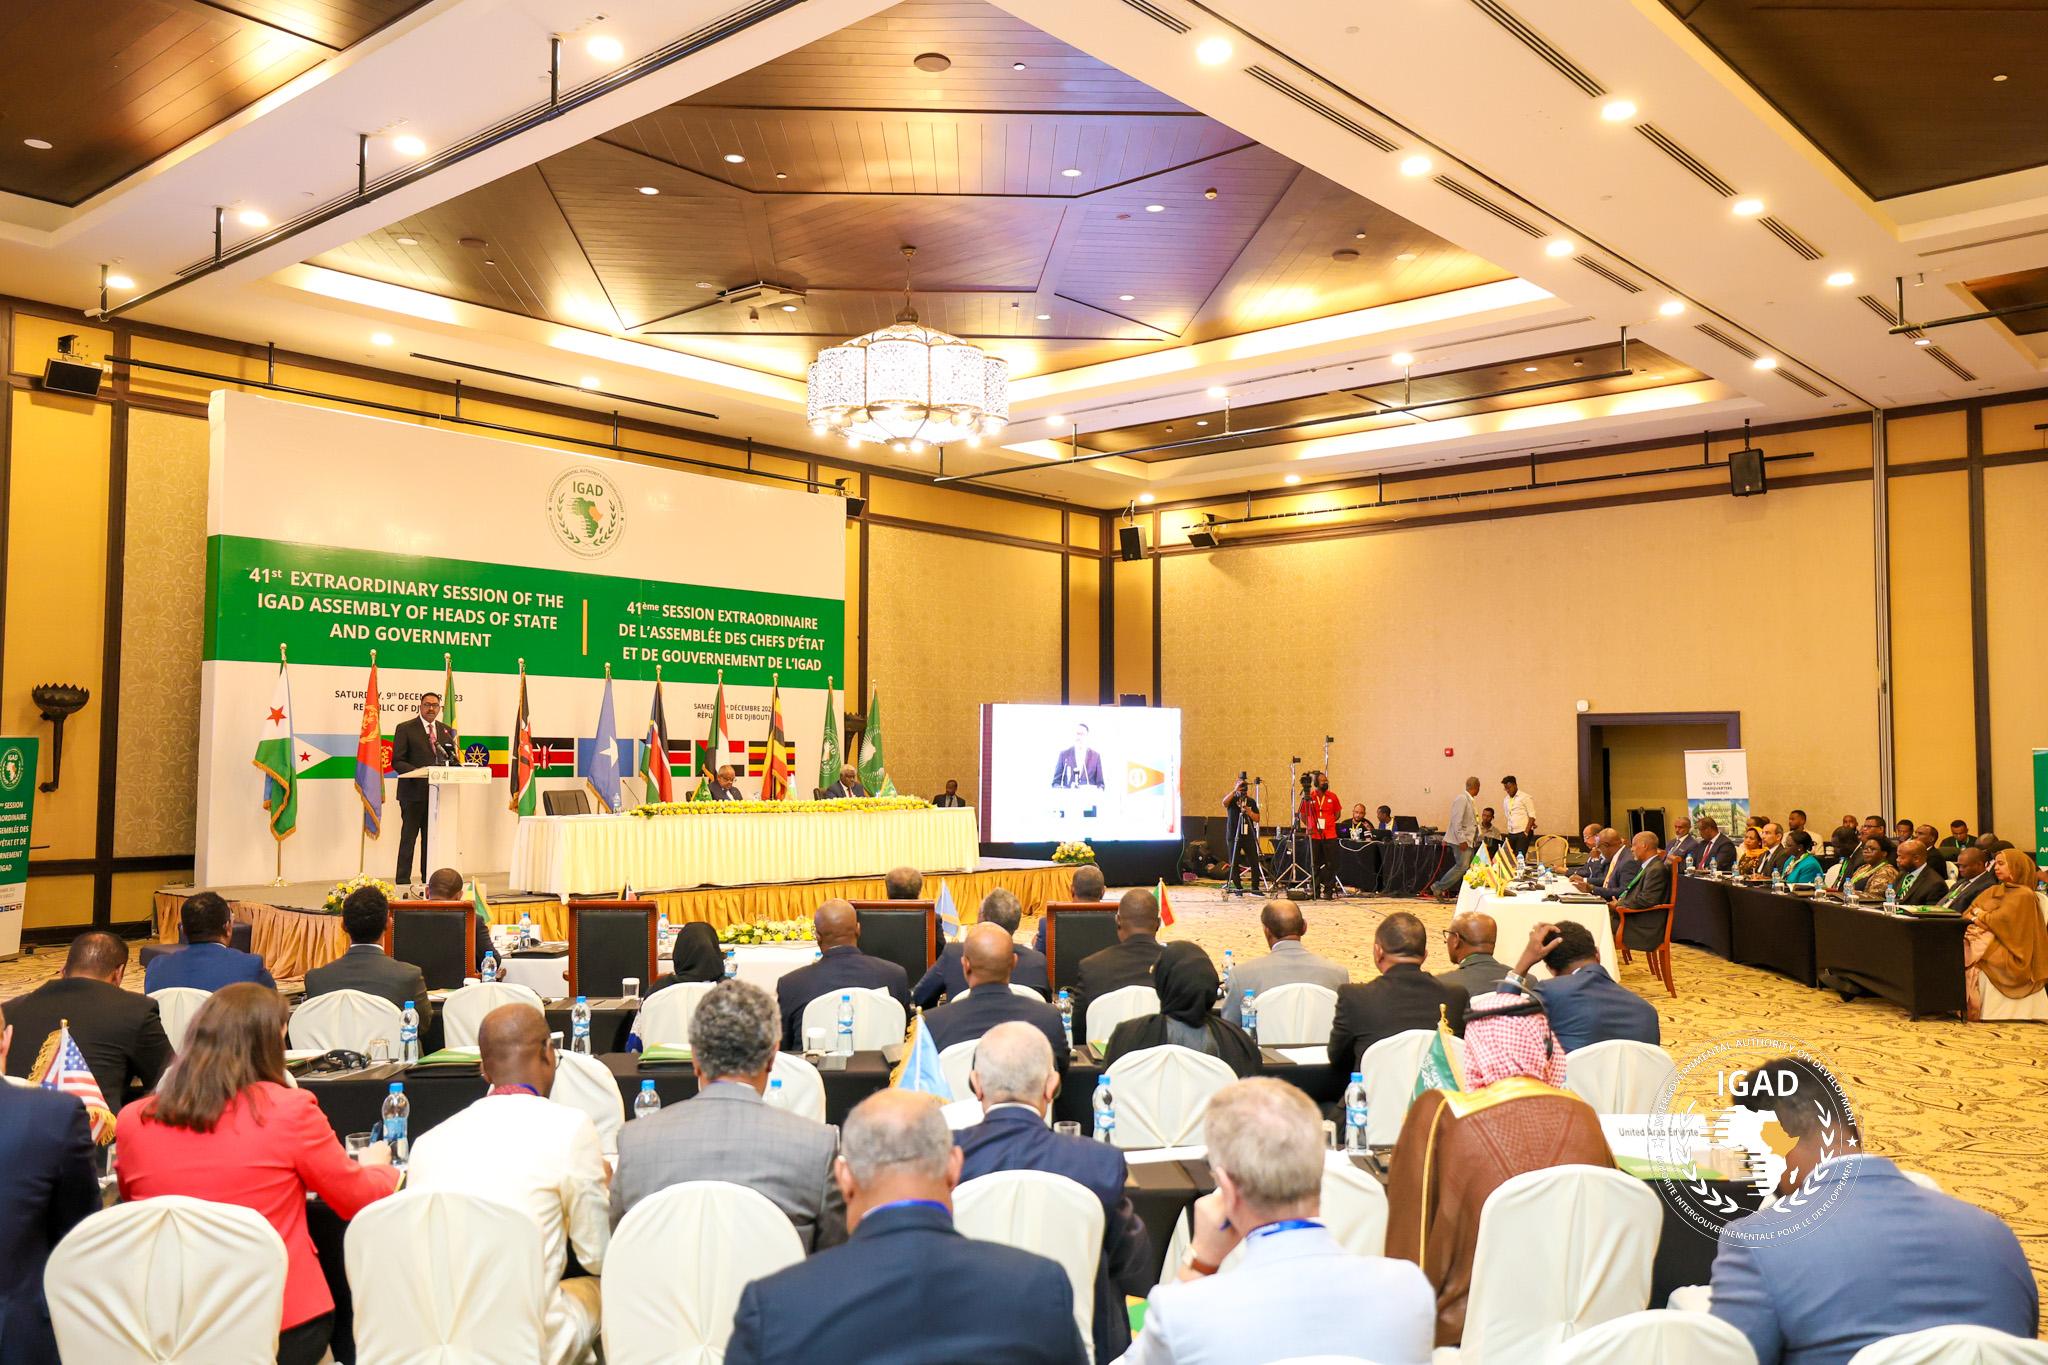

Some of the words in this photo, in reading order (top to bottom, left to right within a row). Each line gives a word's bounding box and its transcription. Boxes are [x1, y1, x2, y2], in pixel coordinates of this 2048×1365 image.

[573, 481, 603, 496] IGAD
[249, 568, 282, 583] 41st
[290, 570, 439, 597] EXTRAORDINARY
[443, 585, 508, 604] SESSION
[512, 592, 532, 605] OF
[536, 593, 564, 609] THE
[257, 593, 304, 610] IGAD
[309, 597, 401, 618] ASSEMBLY
[406, 605, 428, 620] OF
[433, 607, 485, 624] HEADS
[490, 611, 510, 626] OF
[514, 614, 557, 630] STATE
[627, 601, 659, 615] 41ème
[662, 604, 714, 621] SESSION
[718, 609, 818, 630] EXTRAORDINAIRE
[330, 623, 370, 639] AND
[375, 626, 492, 647] GOVERNMENT
[619, 624, 636, 637] DE
[640, 625, 722, 643] L'ASSEMBLÉE
[724, 632, 746, 645] DES
[750, 634, 785, 648] CHEFS
[788, 635, 825, 651] D'ÉTAT
[623, 646, 638, 660] ET
[642, 648, 658, 661] DE
[662, 649, 765, 668] GOUVERNEMENT
[768, 656, 782, 669] DE
[786, 658, 822, 671] L'IGAD
[335, 690, 384, 700] SATURDY,
[399, 692, 442, 701] DECER
[354, 703, 395, 711] REBLIC
[1619, 1128, 1645, 1136] United
[1647, 1128, 1666, 1136] Arab
